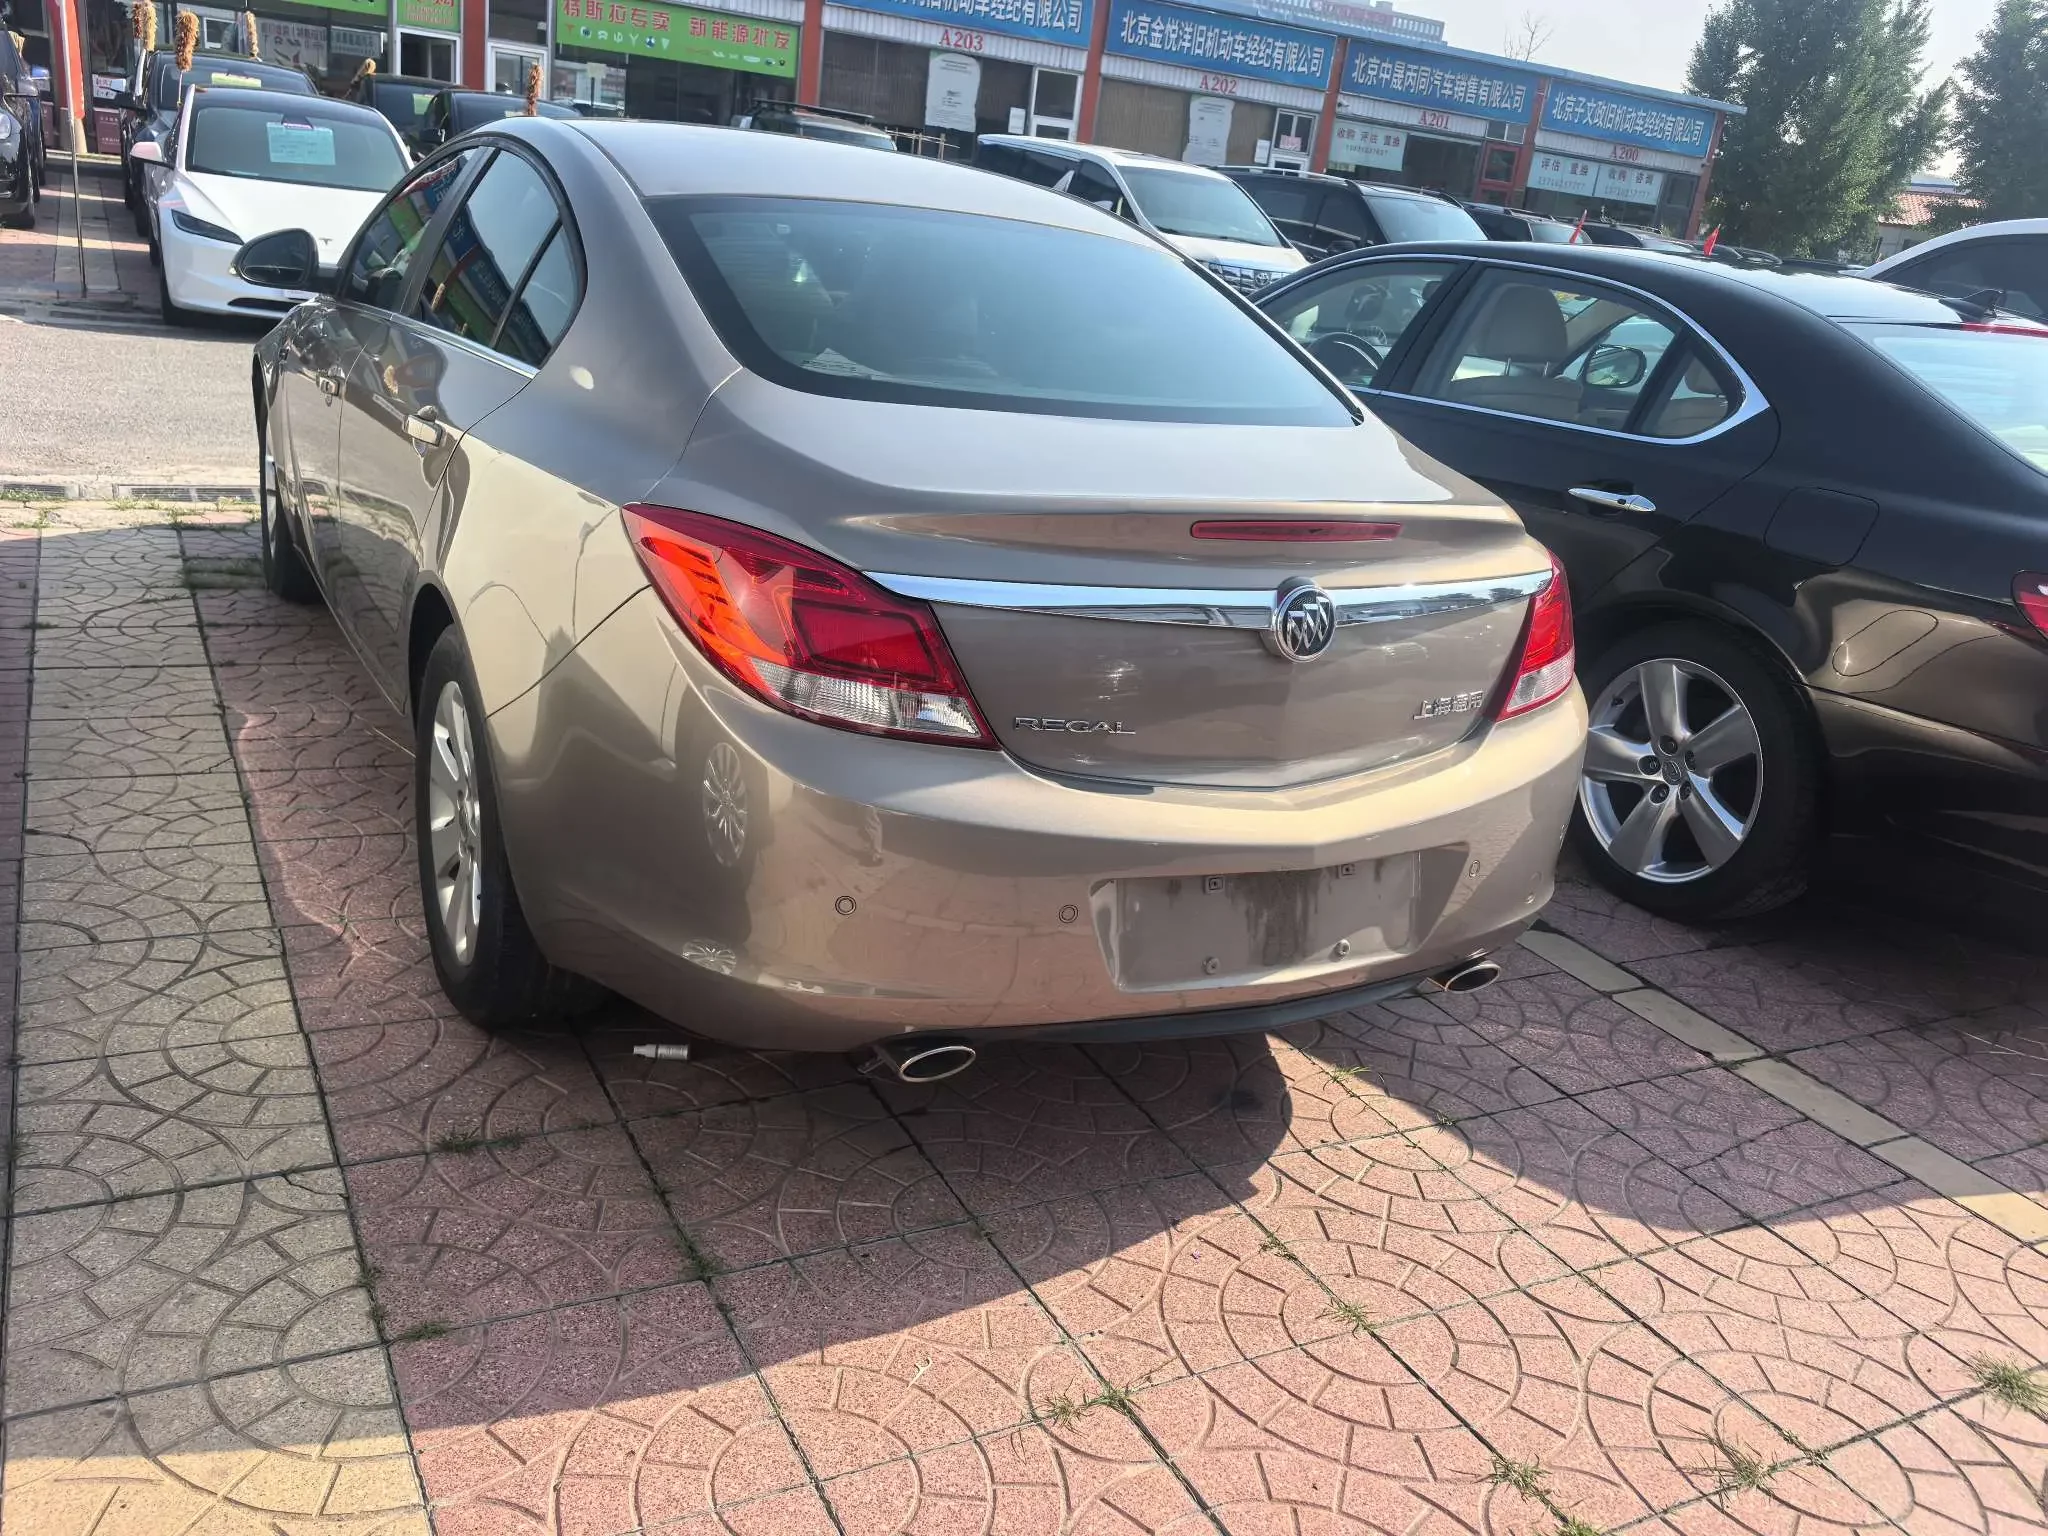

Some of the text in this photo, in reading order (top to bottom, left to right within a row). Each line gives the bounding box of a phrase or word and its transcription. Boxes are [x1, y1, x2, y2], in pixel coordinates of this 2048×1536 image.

[689, 17, 790, 49] 新能源批发
[939, 29, 984, 51] A203
[1121, 10, 1324, 77] 北京金悦洋旧机动车经纪有限公司
[1199, 75, 1238, 95] A202
[1418, 110, 1450, 130] A201
[1610, 145, 1640, 162] A200
[1013, 716, 1136, 736] REGAL
